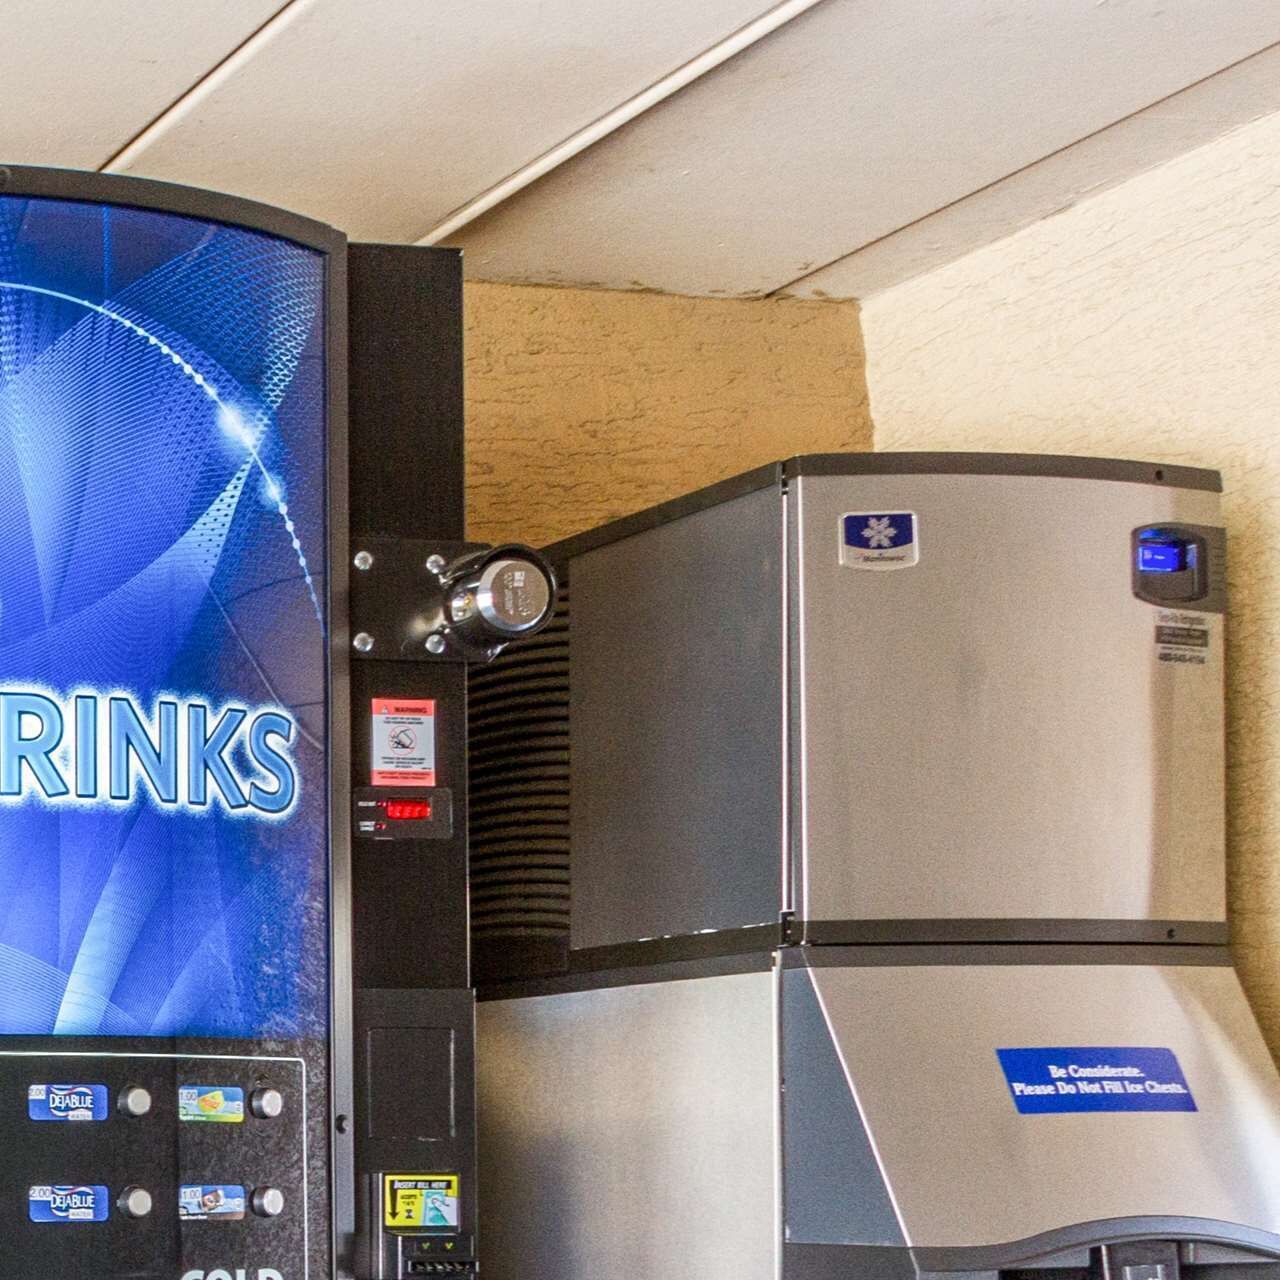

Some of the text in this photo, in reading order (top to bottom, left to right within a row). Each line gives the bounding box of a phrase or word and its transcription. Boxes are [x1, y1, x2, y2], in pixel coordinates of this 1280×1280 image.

[1048, 1064, 1145, 1079] Be Considerate.
[1012, 1080, 1188, 1096] Please Do Not Fill Ice Chests.
